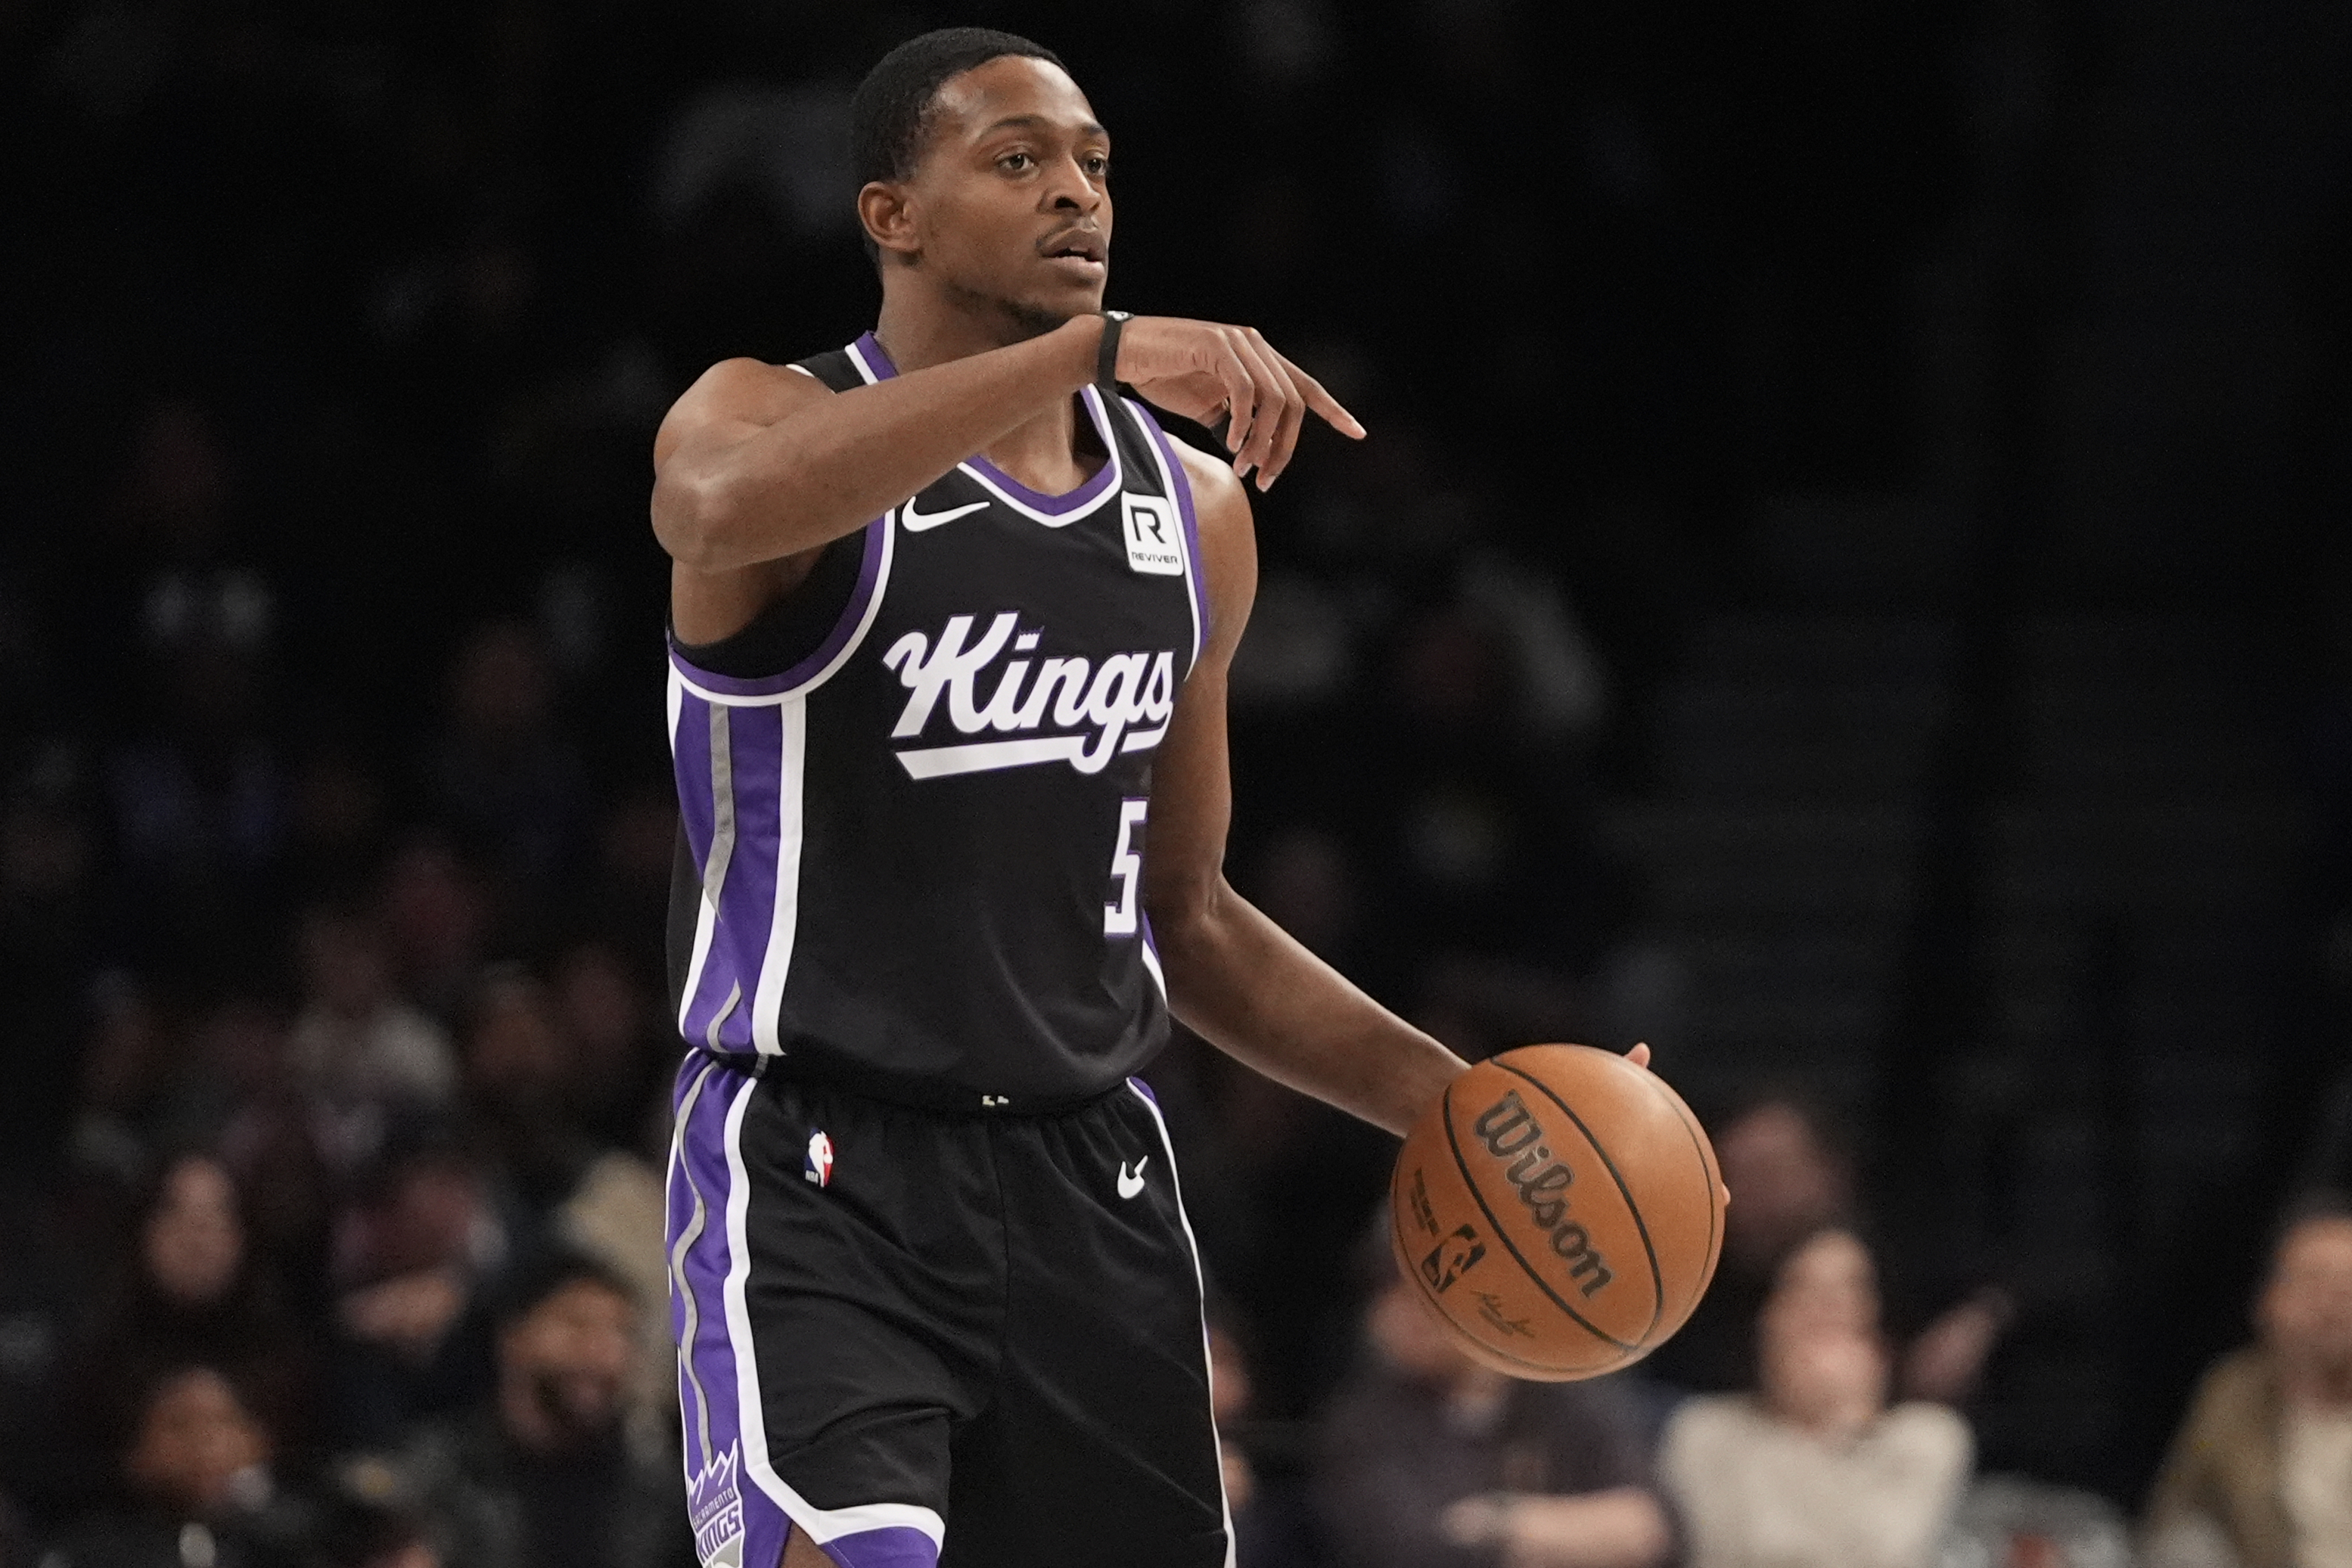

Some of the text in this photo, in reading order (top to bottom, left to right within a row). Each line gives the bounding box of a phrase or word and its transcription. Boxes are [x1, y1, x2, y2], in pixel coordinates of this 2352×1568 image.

[1129, 505, 1166, 544] R
[1131, 551, 1178, 564] REVIVER
[883, 611, 1173, 779] Kings
[1104, 797, 1148, 935] 5
[1476, 1089, 1612, 1296] Wilson
[698, 1504, 741, 1563] KINGS
